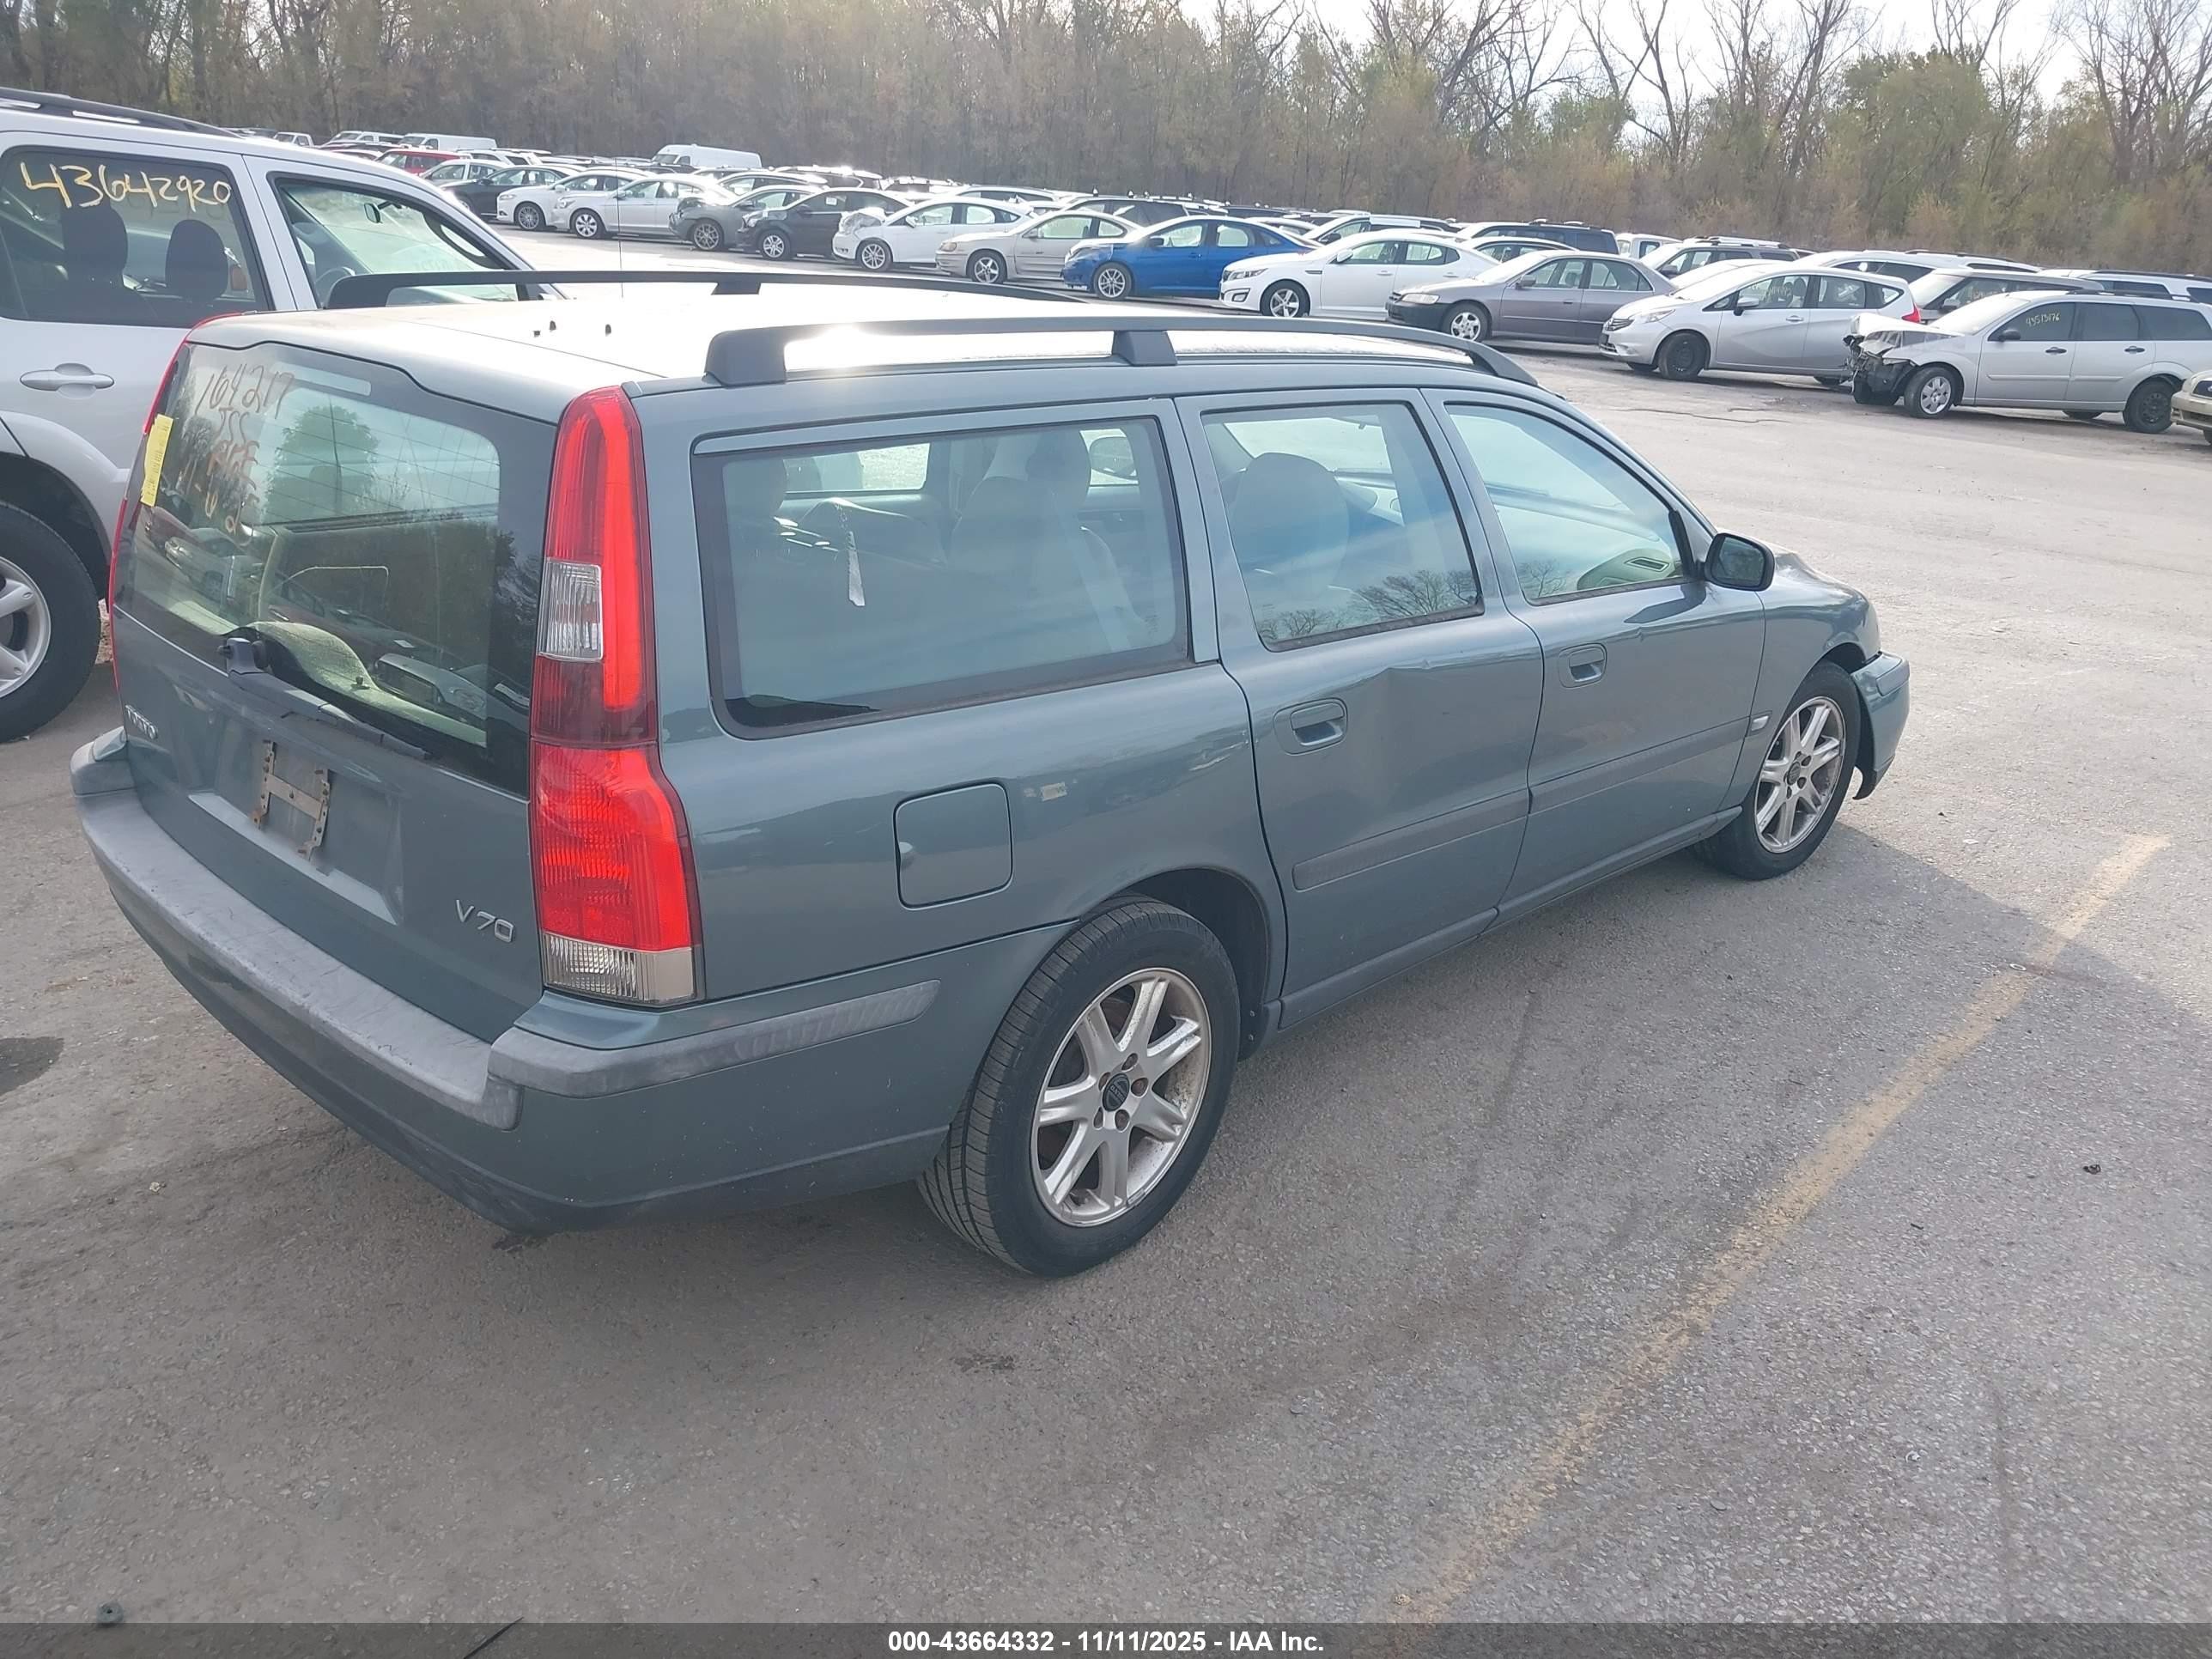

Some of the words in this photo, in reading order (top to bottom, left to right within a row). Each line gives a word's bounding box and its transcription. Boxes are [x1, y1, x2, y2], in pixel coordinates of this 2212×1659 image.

[21, 161, 231, 212] 43642920
[194, 363, 295, 419] 164217
[455, 899, 514, 943] V70
